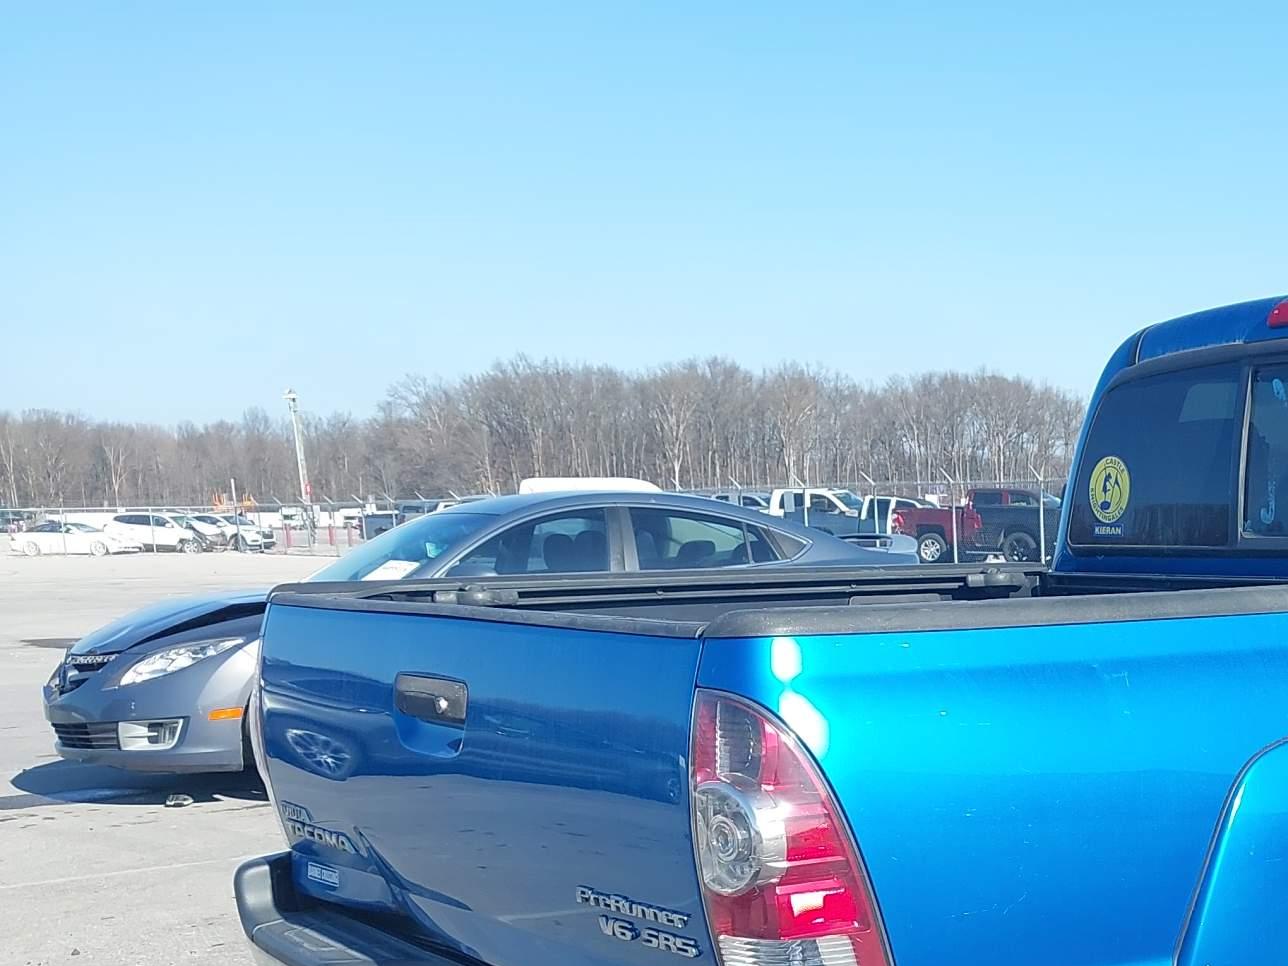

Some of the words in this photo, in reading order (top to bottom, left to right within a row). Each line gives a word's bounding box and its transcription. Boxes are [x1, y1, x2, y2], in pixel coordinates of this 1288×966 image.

[1094, 525, 1122, 535] KIERAN
[286, 821, 357, 855] TACOMA
[575, 885, 689, 929] PreRunner
[598, 915, 636, 942] V6
[641, 928, 701, 958] SR5
